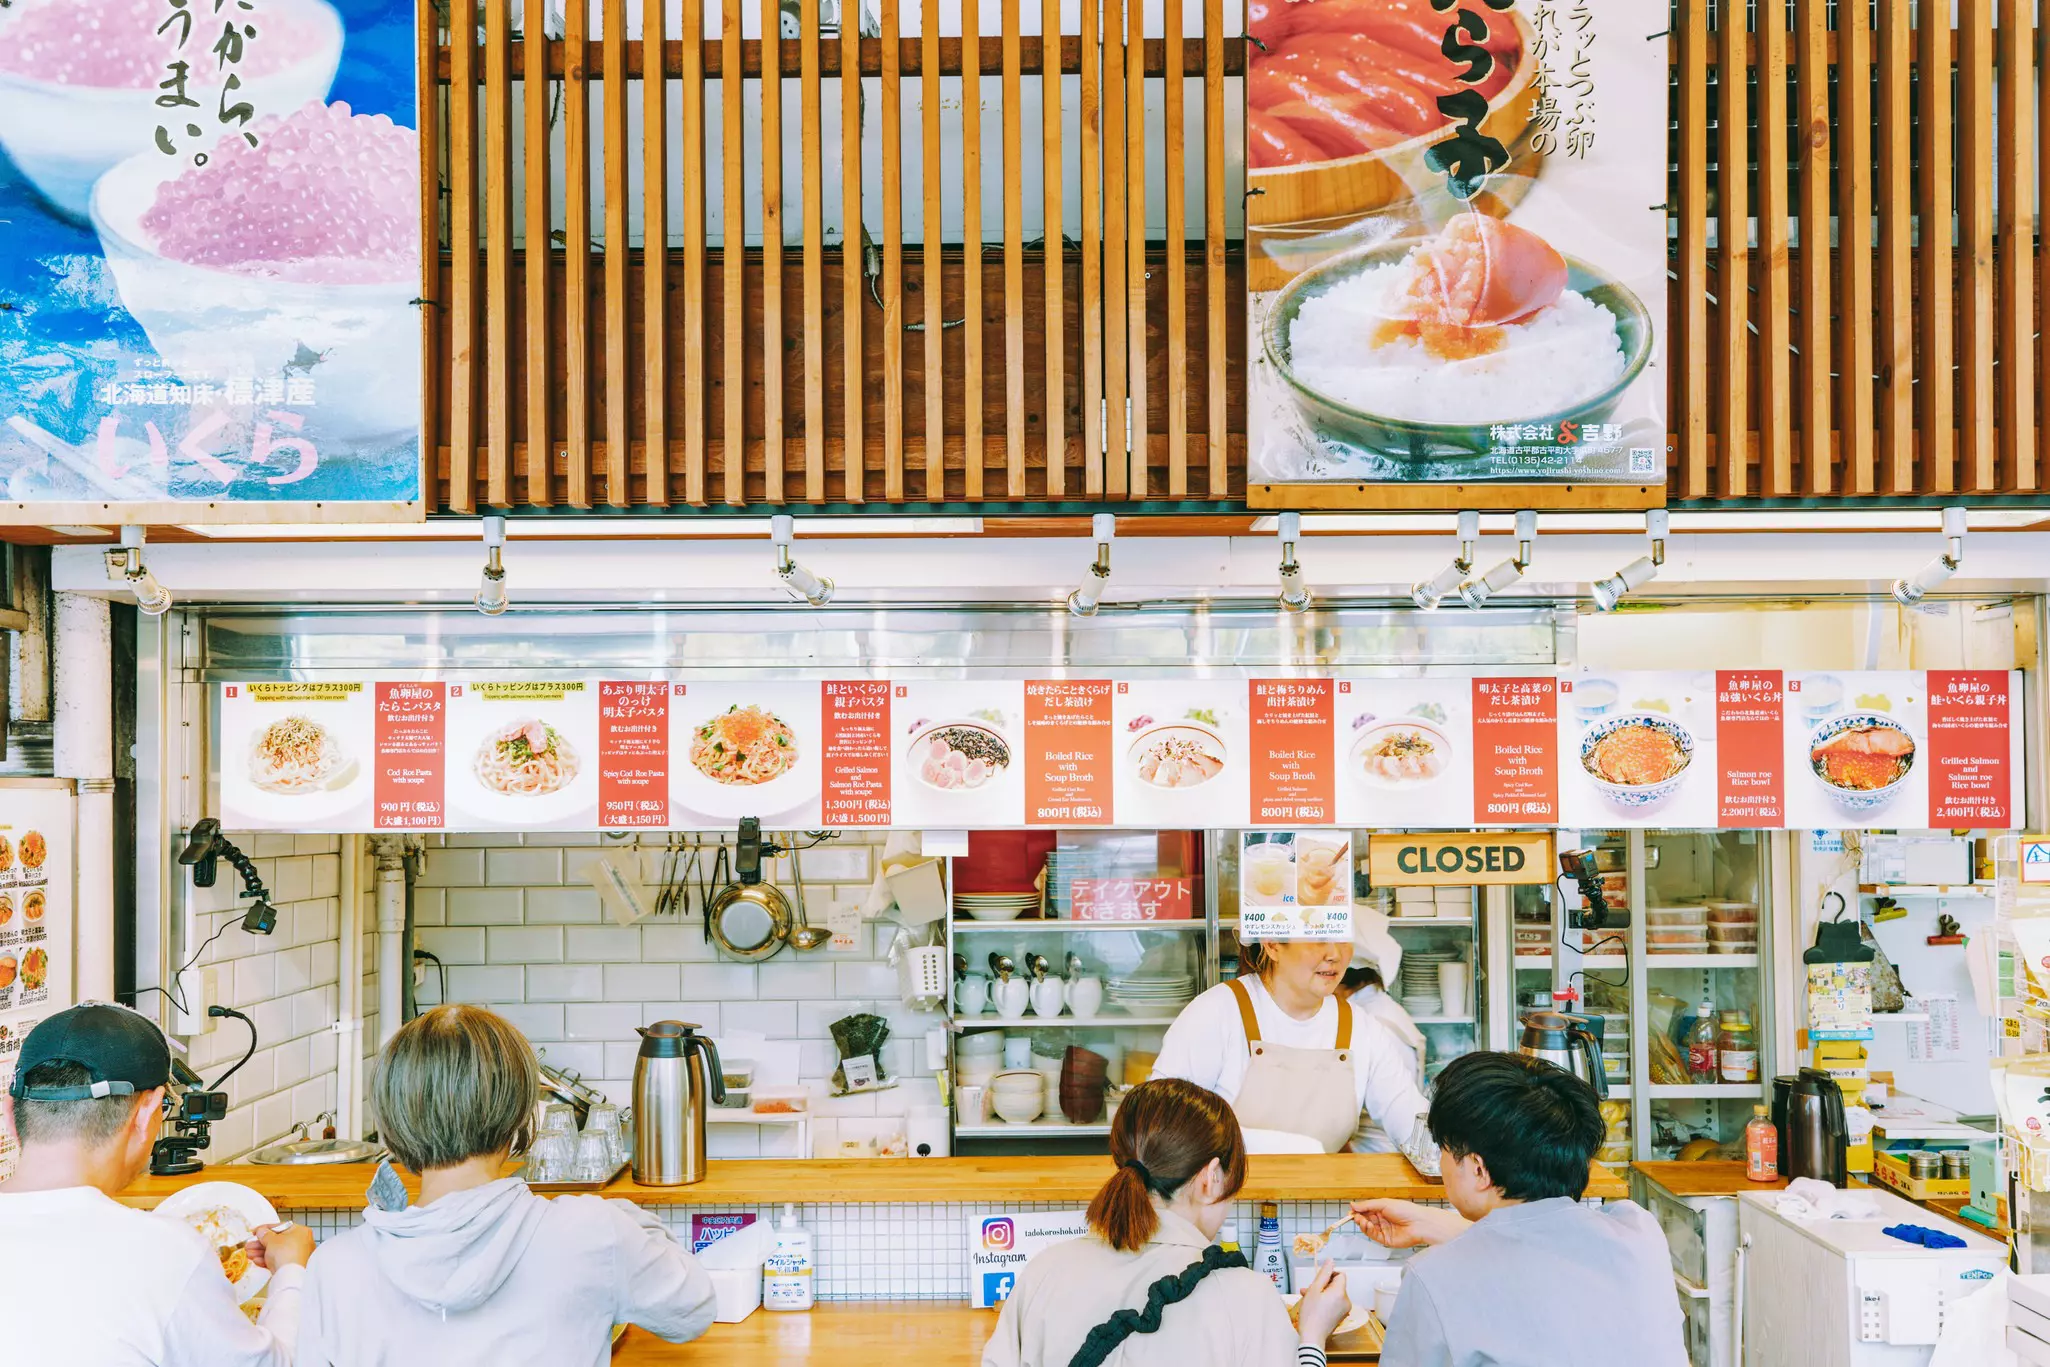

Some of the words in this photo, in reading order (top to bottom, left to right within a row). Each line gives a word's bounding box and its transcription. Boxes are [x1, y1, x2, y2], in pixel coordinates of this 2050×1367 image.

[1490, 424, 1554, 441] 株式会社
[1581, 424, 1623, 442] 吉野
[97, 410, 318, 485] いくら
[1490, 456, 1583, 465] TEL(0135)42-2114
[249, 684, 361, 692] いくらトッピングはプラス300円
[472, 682, 584, 691] いくらトッピングはプラス300円
[603, 684, 668, 695] あぶり明太子
[827, 684, 887, 695] 鮭といくらの
[1027, 685, 1110, 695] 焼きたらこときくらげ
[1256, 685, 1326, 695] 鮭と梅ちりめん
[1479, 683, 1552, 694] 明太子と高菜の
[1728, 680, 1773, 690] 魚卵屋の
[1948, 683, 1990, 693] 魚卵屋の
[389, 688, 433, 699] 魚卵屋の
[1720, 692, 1783, 702] 最強いくら丼
[619, 696, 651, 706] のっけ
[834, 696, 884, 708] 親子パスタ
[1044, 697, 1093, 707] だし茶漬け
[1267, 696, 1316, 707] 出汁茶漬け
[1491, 695, 1541, 705] だし茶漬け
[1931, 694, 2007, 705] 鮭・いくら親子丼
[379, 701, 441, 711] たらこパスタ
[603, 707, 665, 718] 明太子パスタ
[388, 714, 434, 722] 飲むお出汁付き
[1495, 745, 1522, 754] Boiled
[1524, 745, 1543, 754] Rice
[1045, 752, 1072, 760] Boiled
[1075, 752, 1094, 760] Rice
[1269, 751, 1295, 759] Boiled
[1297, 751, 1316, 759] Rice
[1282, 761, 1300, 769] with
[1508, 756, 1527, 765] with
[1941, 756, 1968, 765] Grilled
[1970, 756, 2000, 765] Salmon
[856, 766, 878, 774] Salmon
[1059, 763, 1078, 771] with
[1494, 766, 1517, 777] Soup
[1519, 766, 1543, 775] Broth
[1963, 765, 1978, 773] and
[1045, 773, 1067, 783] Soup
[1069, 773, 1094, 782] Broth
[1269, 772, 1290, 782] Soup
[1293, 772, 1316, 780] Broth
[1727, 770, 1757, 779] Salmon
[1948, 773, 1977, 781] Salmon
[829, 781, 851, 789] Salmon
[1731, 778, 1749, 786] Rice
[1751, 778, 1771, 786] bowl
[1951, 781, 1969, 789] Rice
[1971, 781, 1990, 789] bowl
[1724, 795, 1777, 805] 飲むお出汁付き
[1944, 796, 1996, 805] 飲むお出汁付き
[1038, 807, 1070, 818] 800円
[1261, 807, 1292, 818] 800円
[1488, 803, 1519, 813] 800円
[1397, 846, 1525, 874] CLOSED
[1072, 881, 1190, 900] テイクアウト
[1283, 894, 1294, 902] ice
[1075, 901, 1162, 920] できます
[1244, 913, 1265, 922] ¥400
[1327, 913, 1348, 921] ¥400
[1025, 1226, 1089, 1237] tadokoroshokuhi
[973, 1252, 1027, 1267] Instagram
